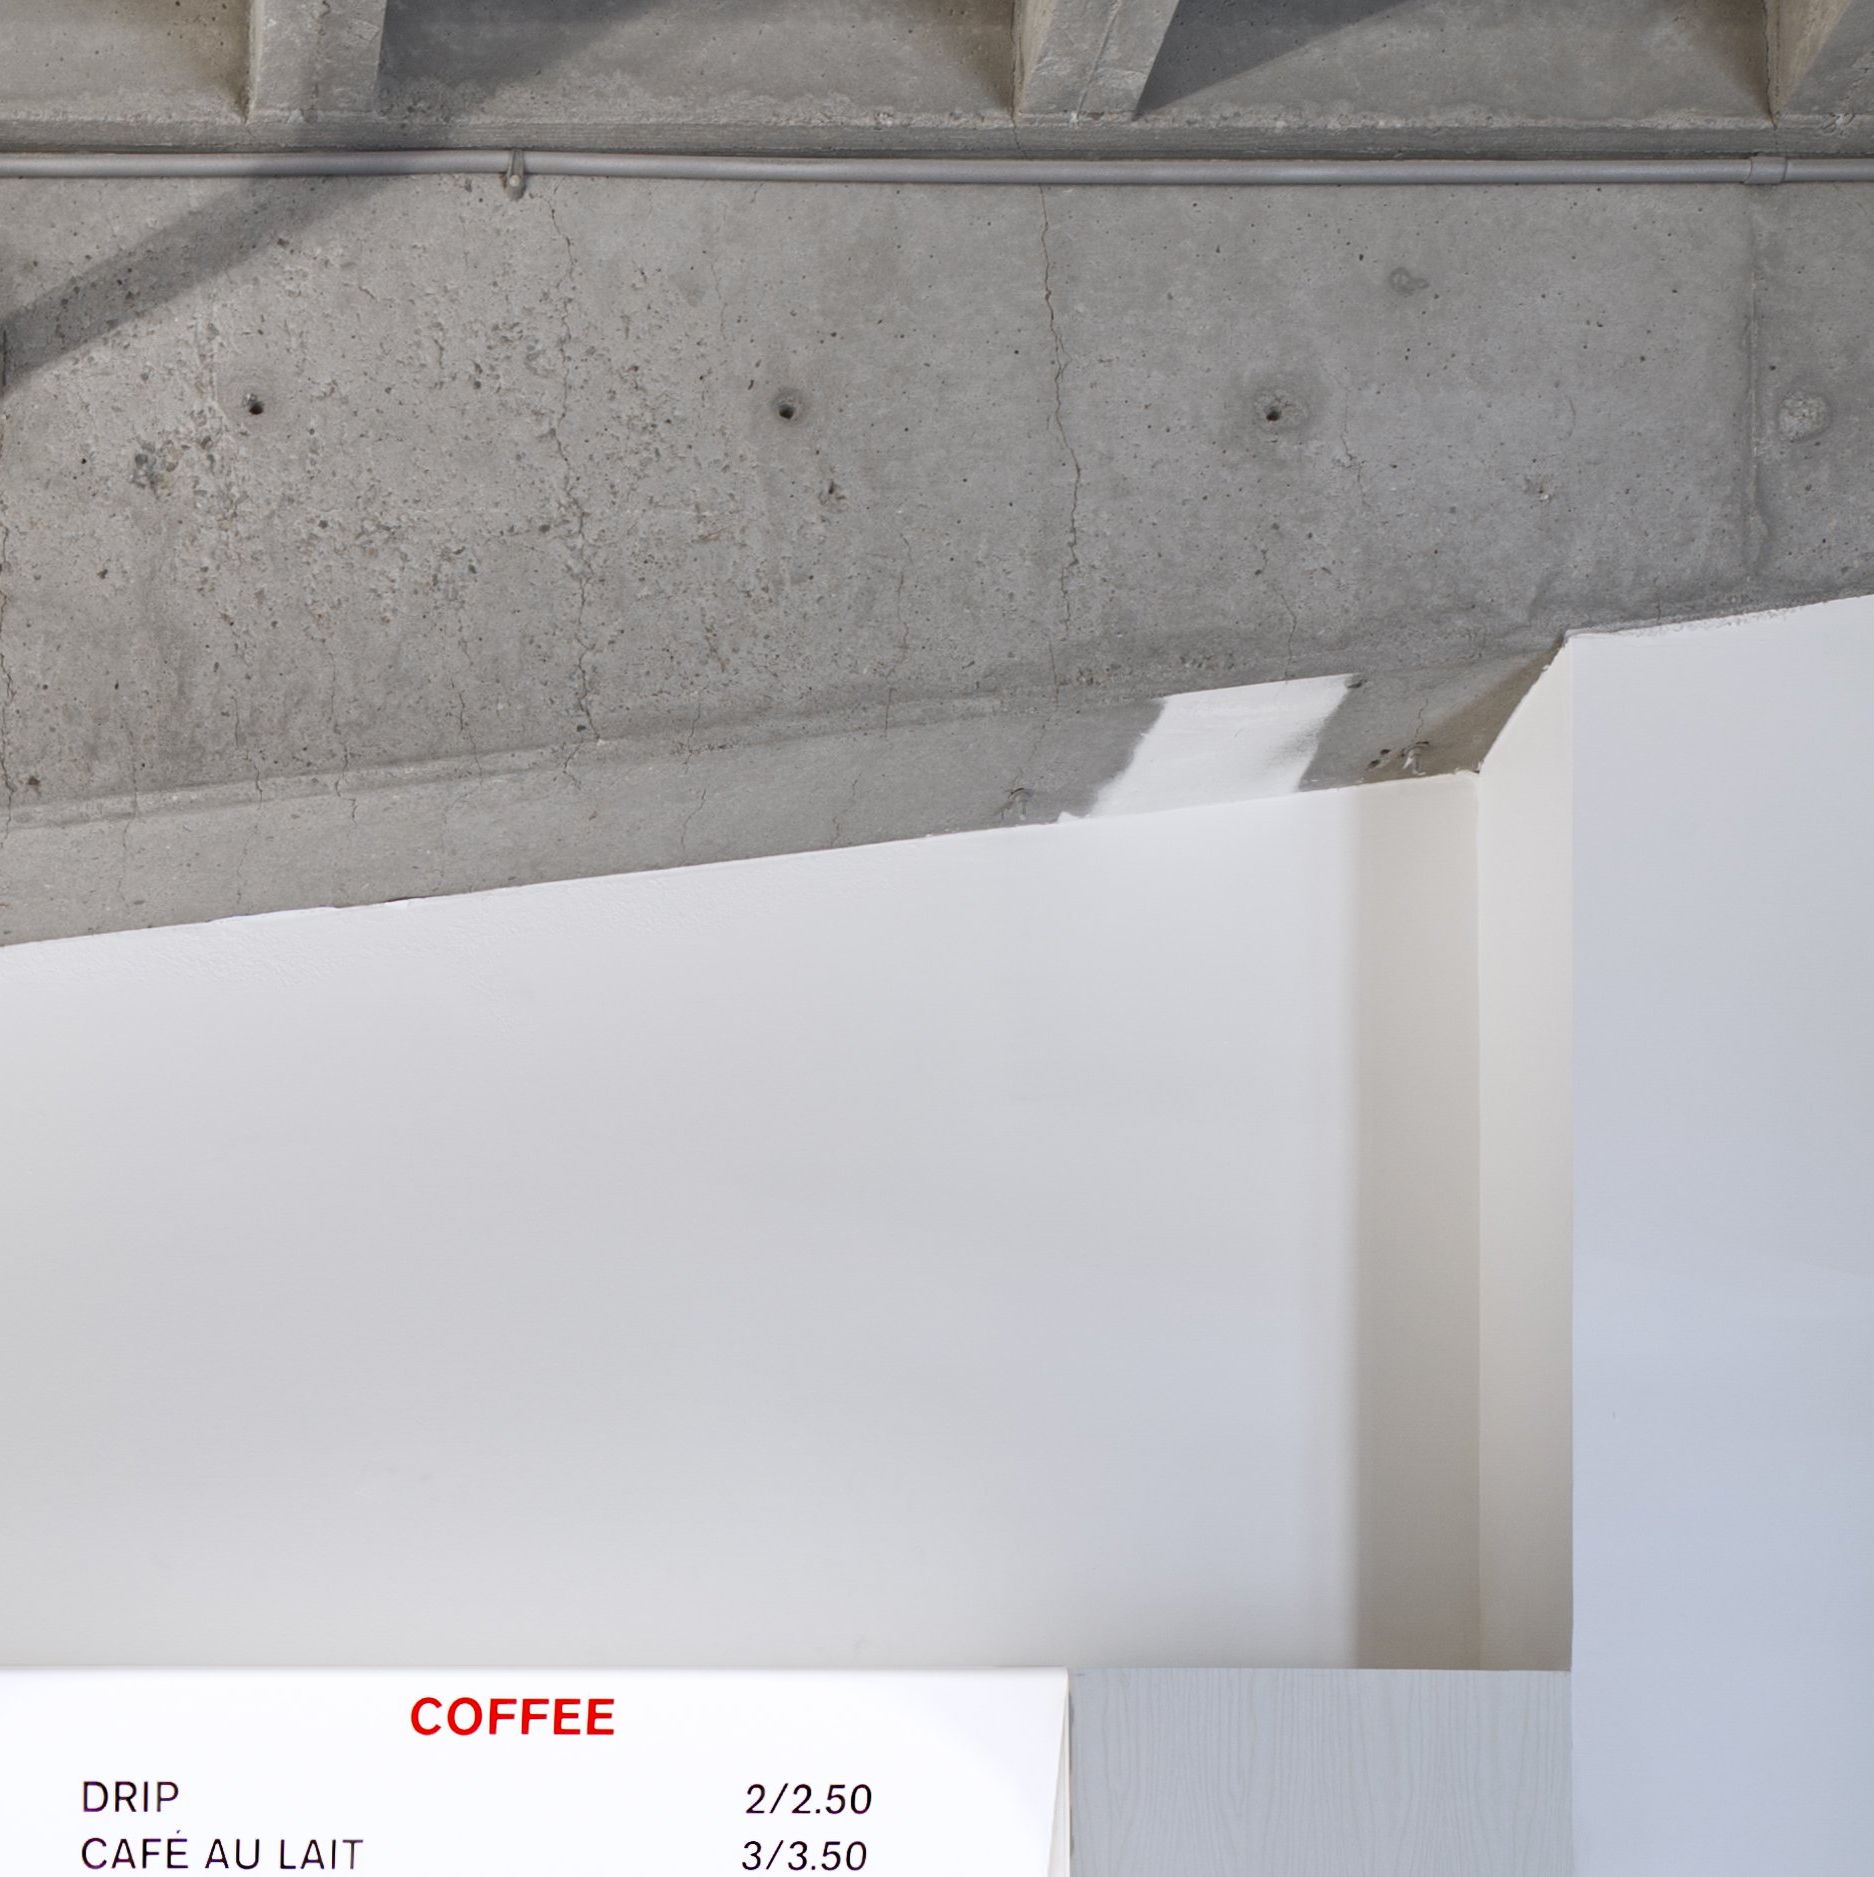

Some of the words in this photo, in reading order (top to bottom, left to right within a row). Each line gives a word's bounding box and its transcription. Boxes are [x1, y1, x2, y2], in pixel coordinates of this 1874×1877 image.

[411, 1697, 614, 1736] COFFEE
[83, 1781, 179, 1812] DRIP
[746, 1783, 872, 1814] 2/2.50
[82, 1830, 189, 1870] CAFÉ
[205, 1838, 260, 1870] AU
[280, 1839, 363, 1869] LAIT
[742, 1840, 867, 1871] 3/3.50
